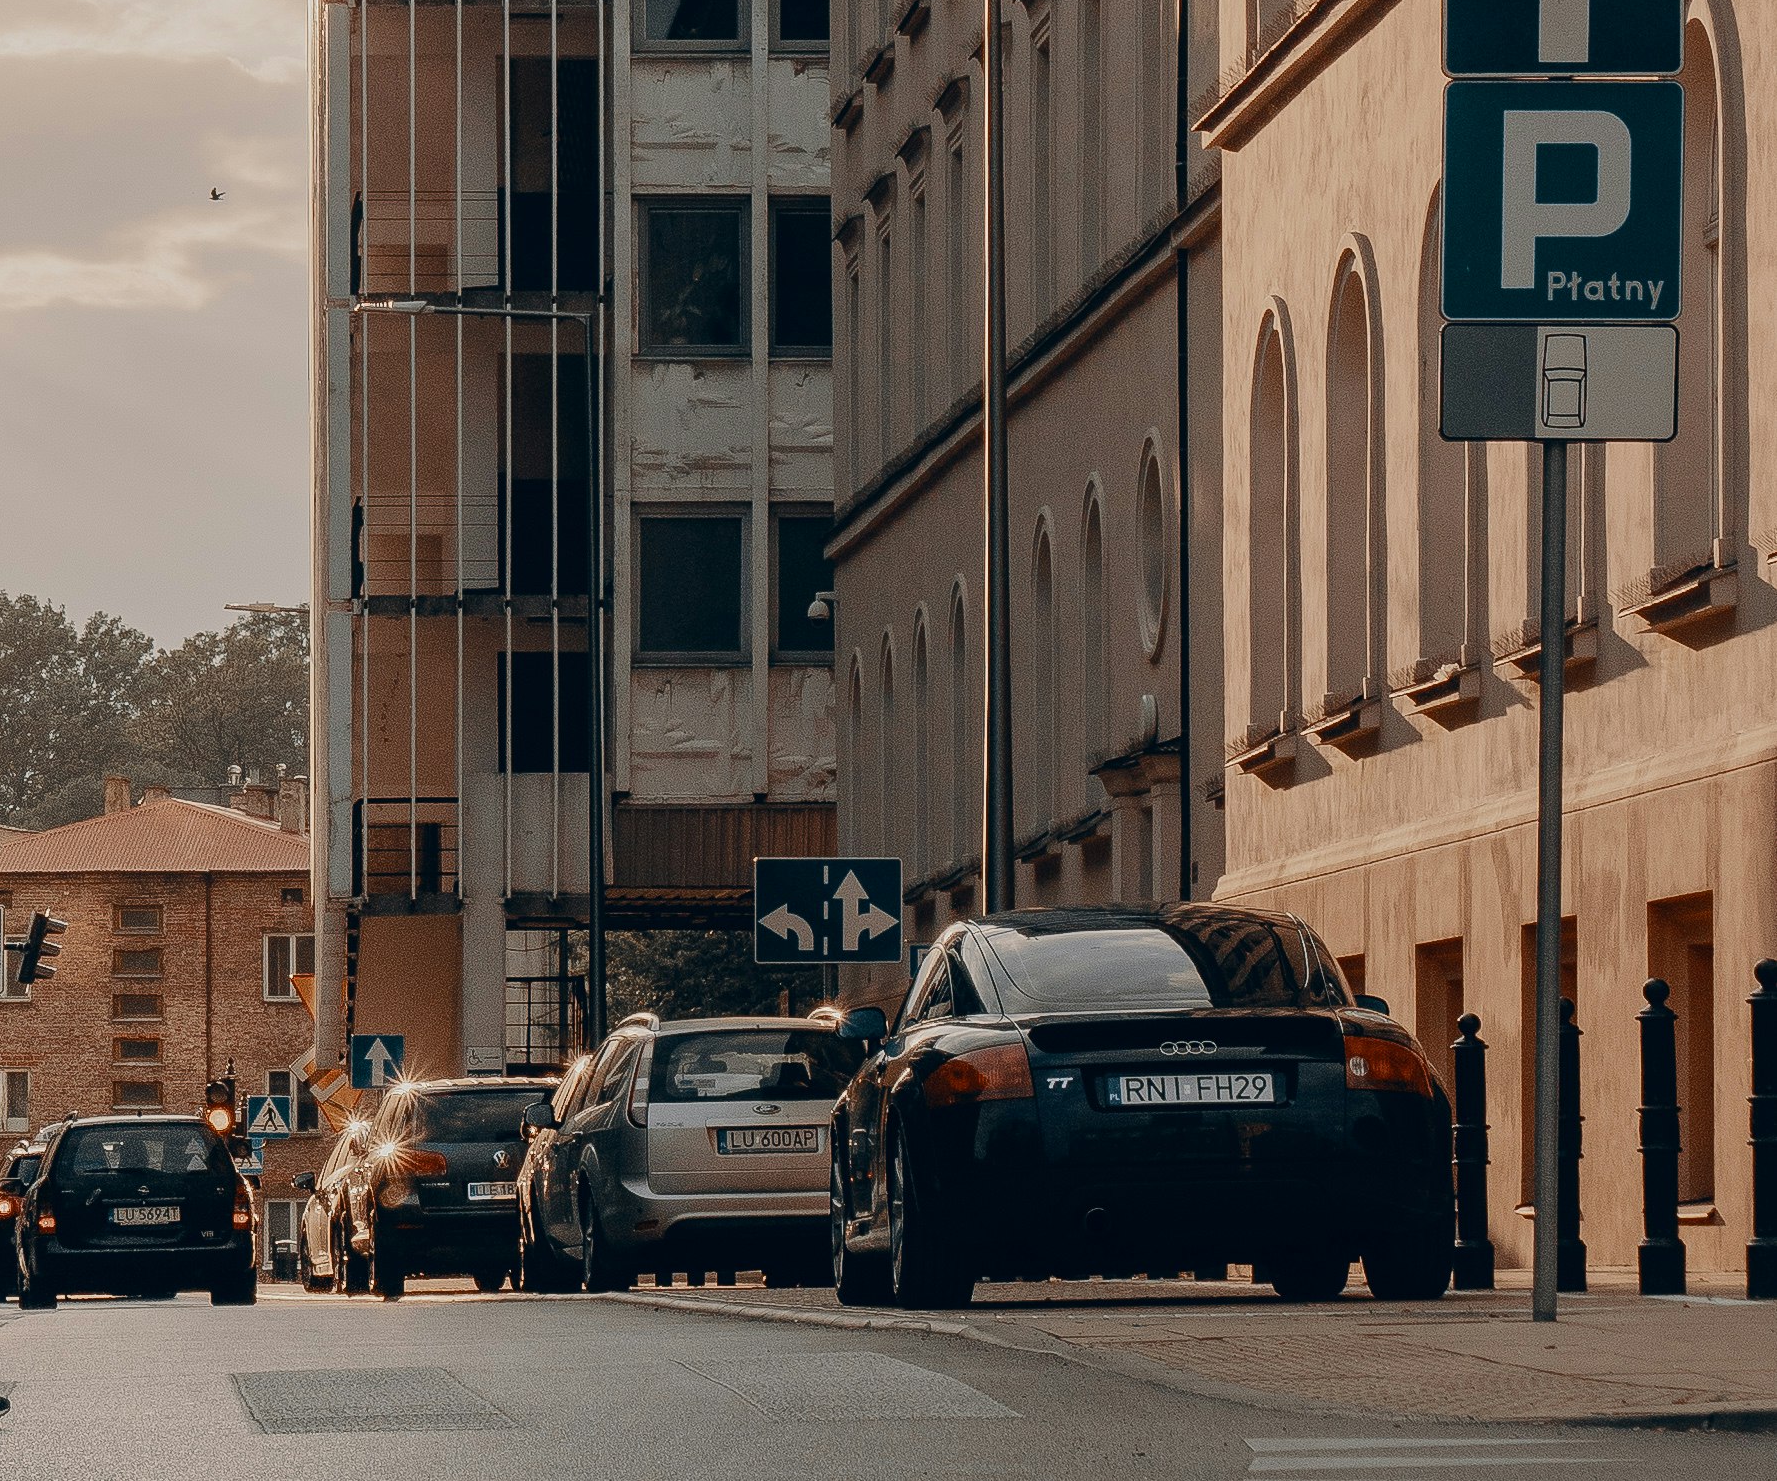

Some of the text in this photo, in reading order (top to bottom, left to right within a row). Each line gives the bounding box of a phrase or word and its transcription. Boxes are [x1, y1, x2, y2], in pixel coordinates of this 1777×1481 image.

[1501, 110, 1632, 288] P
[1548, 271, 1664, 310] Płatny
[1047, 1077, 1074, 1089] TT
[1124, 1075, 1267, 1102] RNI FH29
[1109, 1093, 1120, 1101] PL
[730, 1131, 755, 1148] LU
[761, 1130, 814, 1148] 600AP
[117, 1208, 135, 1221] LU
